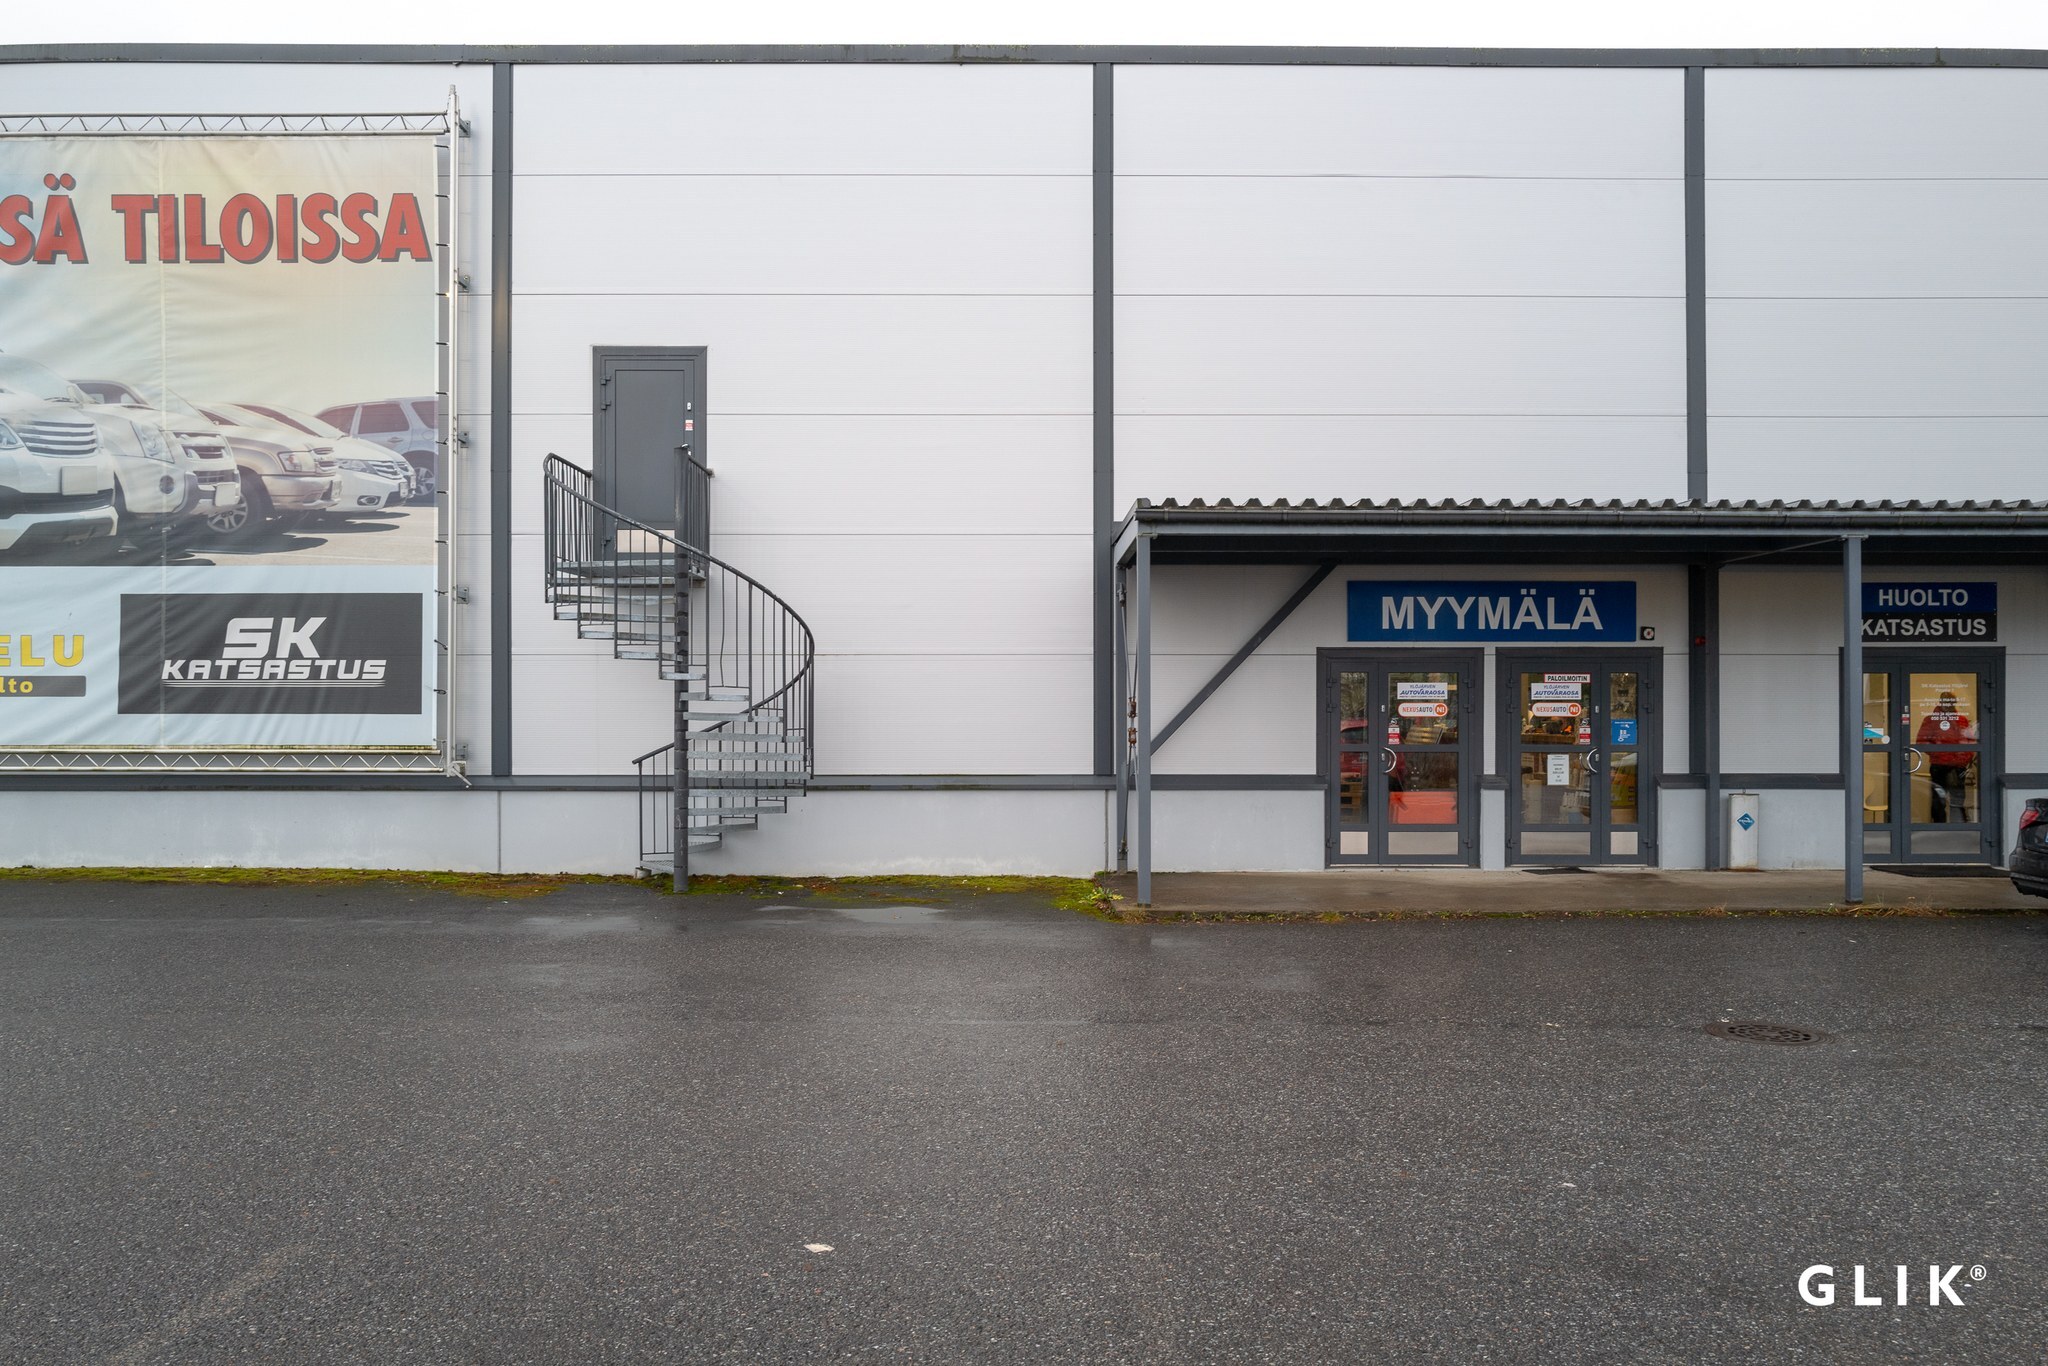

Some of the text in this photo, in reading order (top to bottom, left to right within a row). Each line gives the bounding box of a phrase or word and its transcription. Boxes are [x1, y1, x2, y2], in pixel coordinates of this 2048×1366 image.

[0, 173, 433, 265] SÄ TILOISSA
[1381, 588, 1604, 630] MYYMÄLÄ
[1878, 588, 1969, 607] HUOLTO
[222, 616, 328, 659] SK
[1861, 618, 1987, 636] KATSASTUS
[161, 658, 388, 681] KATSASTUS
